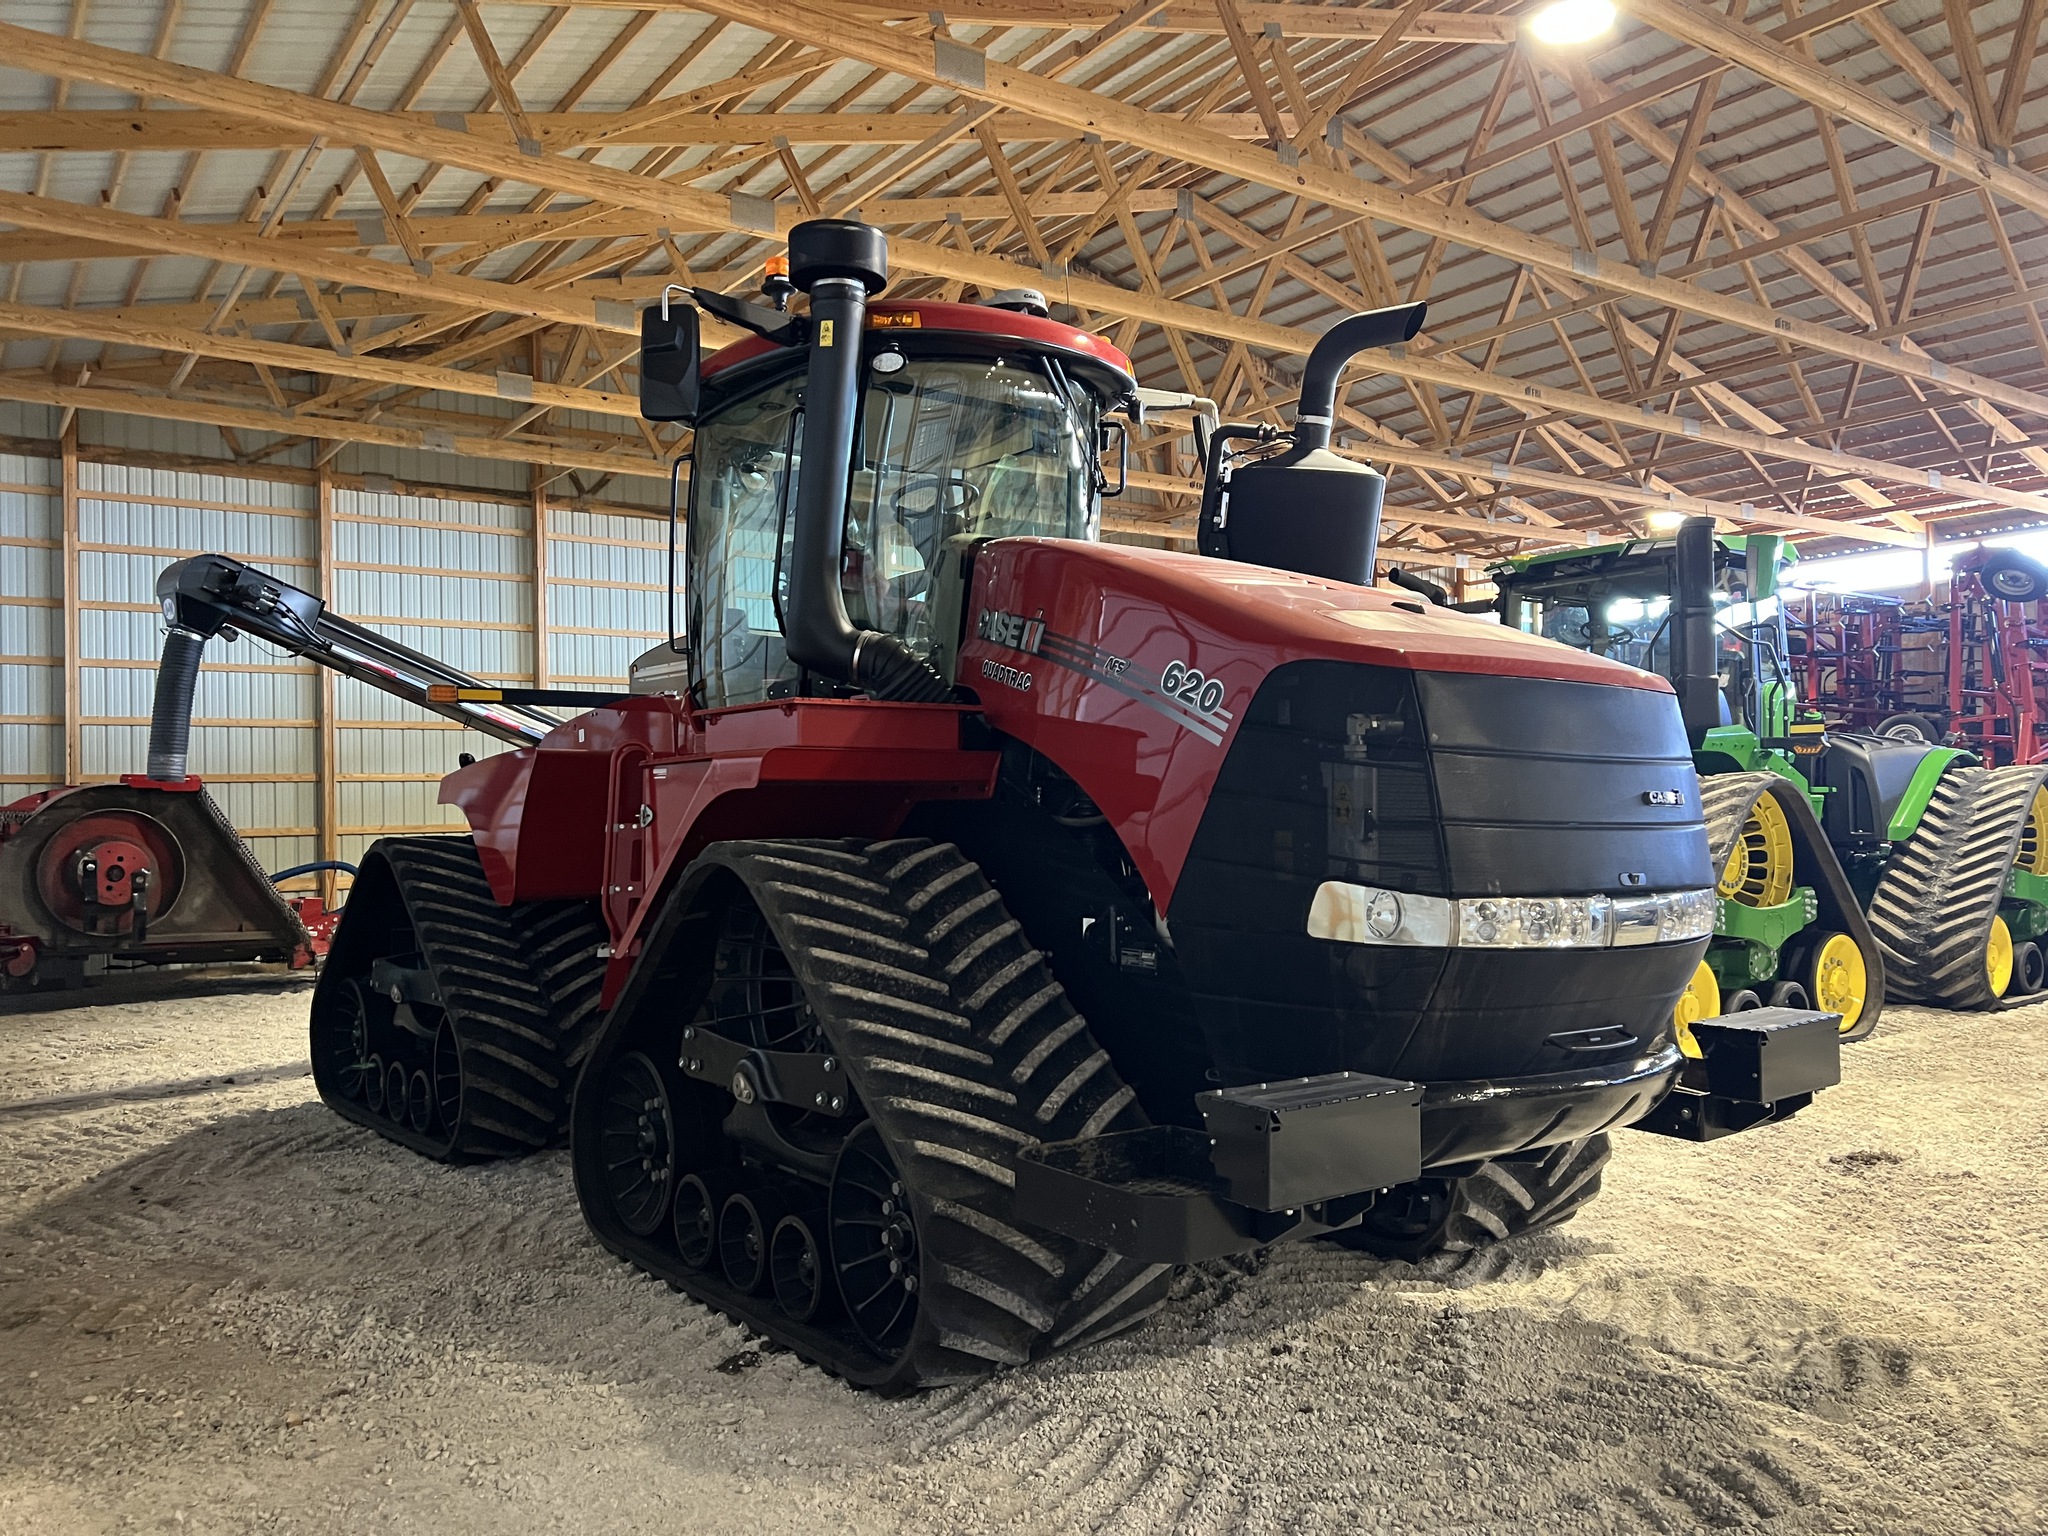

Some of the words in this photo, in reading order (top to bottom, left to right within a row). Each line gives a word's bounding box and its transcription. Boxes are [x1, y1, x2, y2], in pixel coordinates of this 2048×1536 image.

[979, 607, 1024, 648] CASE
[982, 660, 1032, 692] QUADTRAC
[1103, 655, 1127, 677] AFS
[1161, 660, 1225, 716] 620
